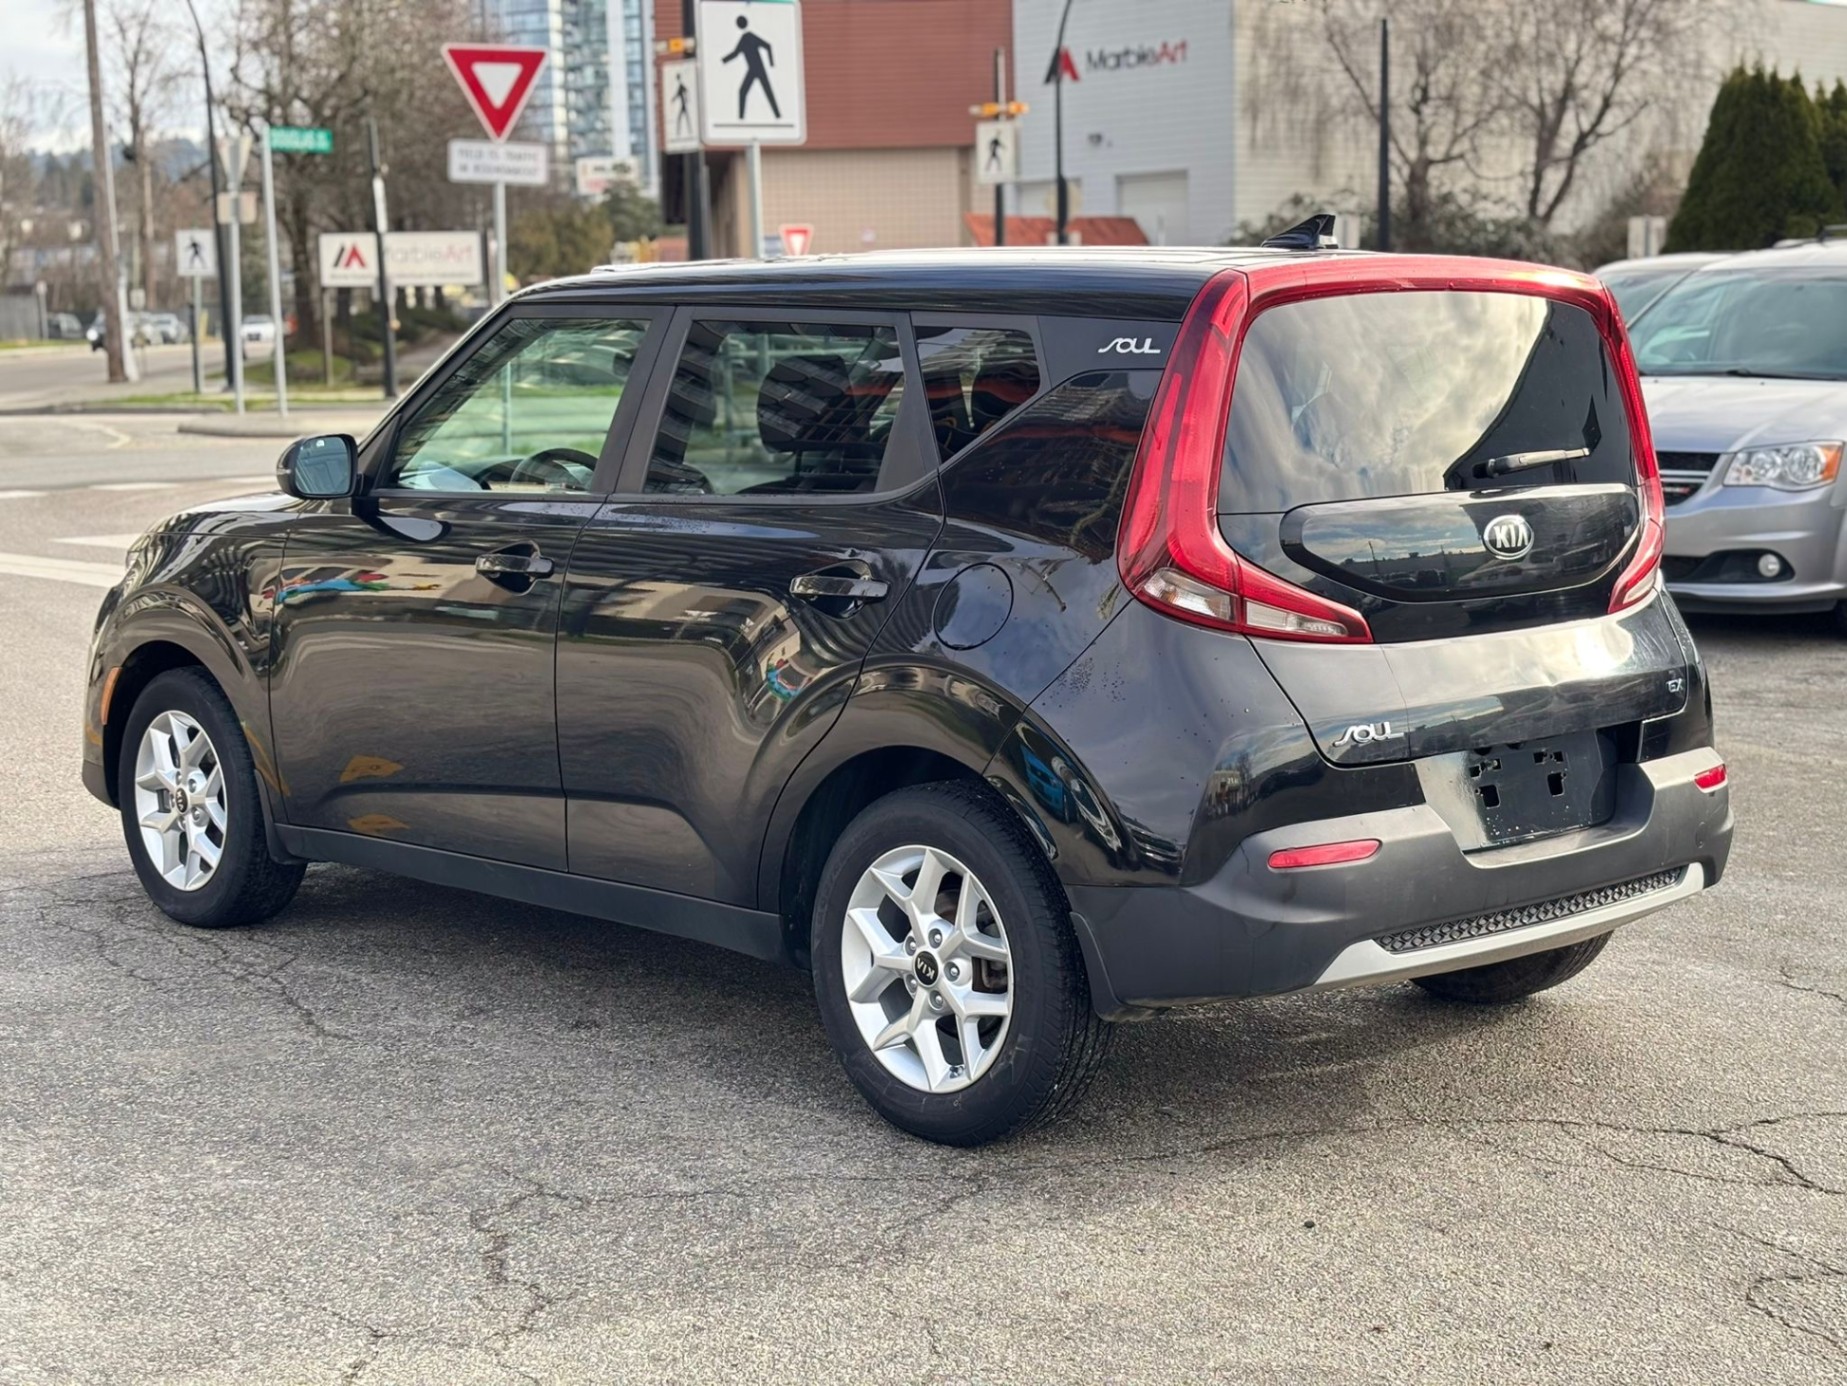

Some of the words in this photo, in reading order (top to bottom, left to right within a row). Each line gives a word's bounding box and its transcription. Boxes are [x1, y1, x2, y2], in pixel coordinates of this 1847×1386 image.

[1086, 40, 1187, 71] MarbleArt
[383, 243, 474, 264] arbleArt
[1493, 524, 1529, 549] KIA
[917, 957, 935, 980] KIA
